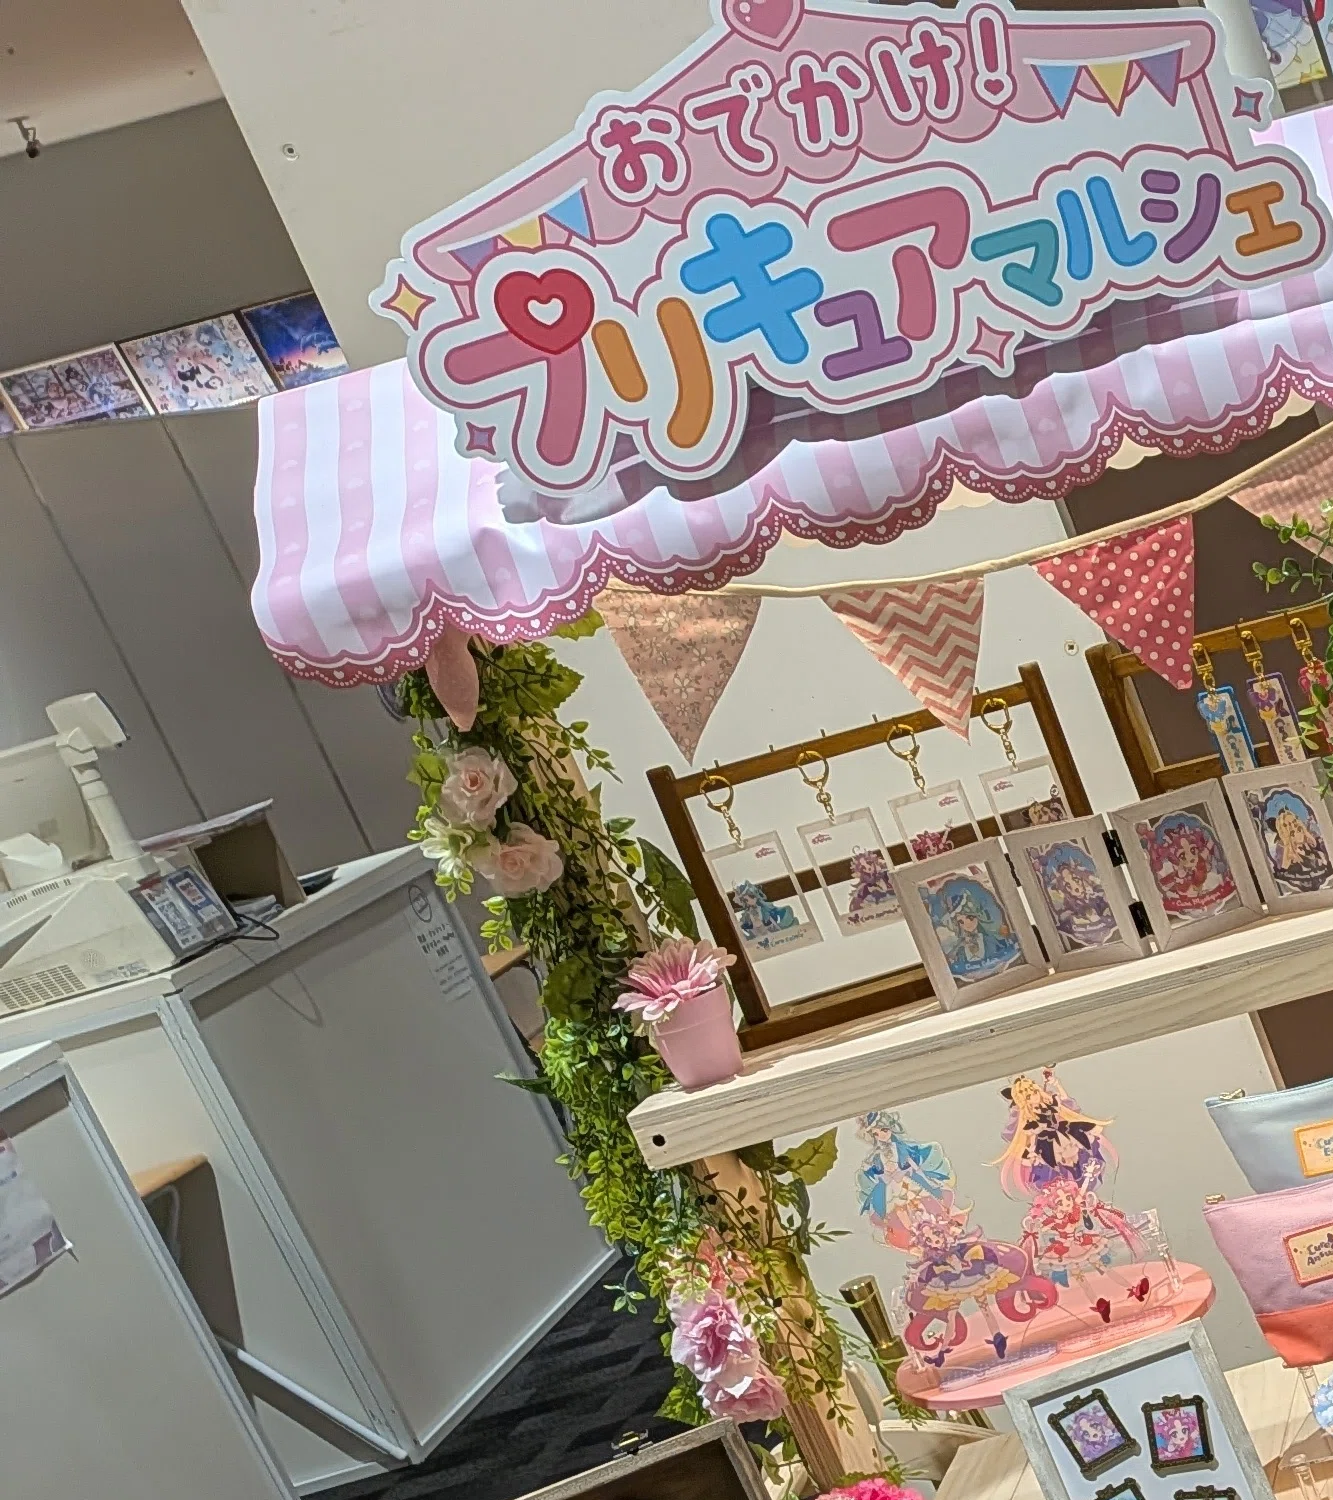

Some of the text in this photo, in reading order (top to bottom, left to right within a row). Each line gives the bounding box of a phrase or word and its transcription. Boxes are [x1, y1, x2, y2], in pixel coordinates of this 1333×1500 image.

[604, 8, 1008, 196] おでかけ!
[444, 168, 1308, 468] プリキュアマルシェ
